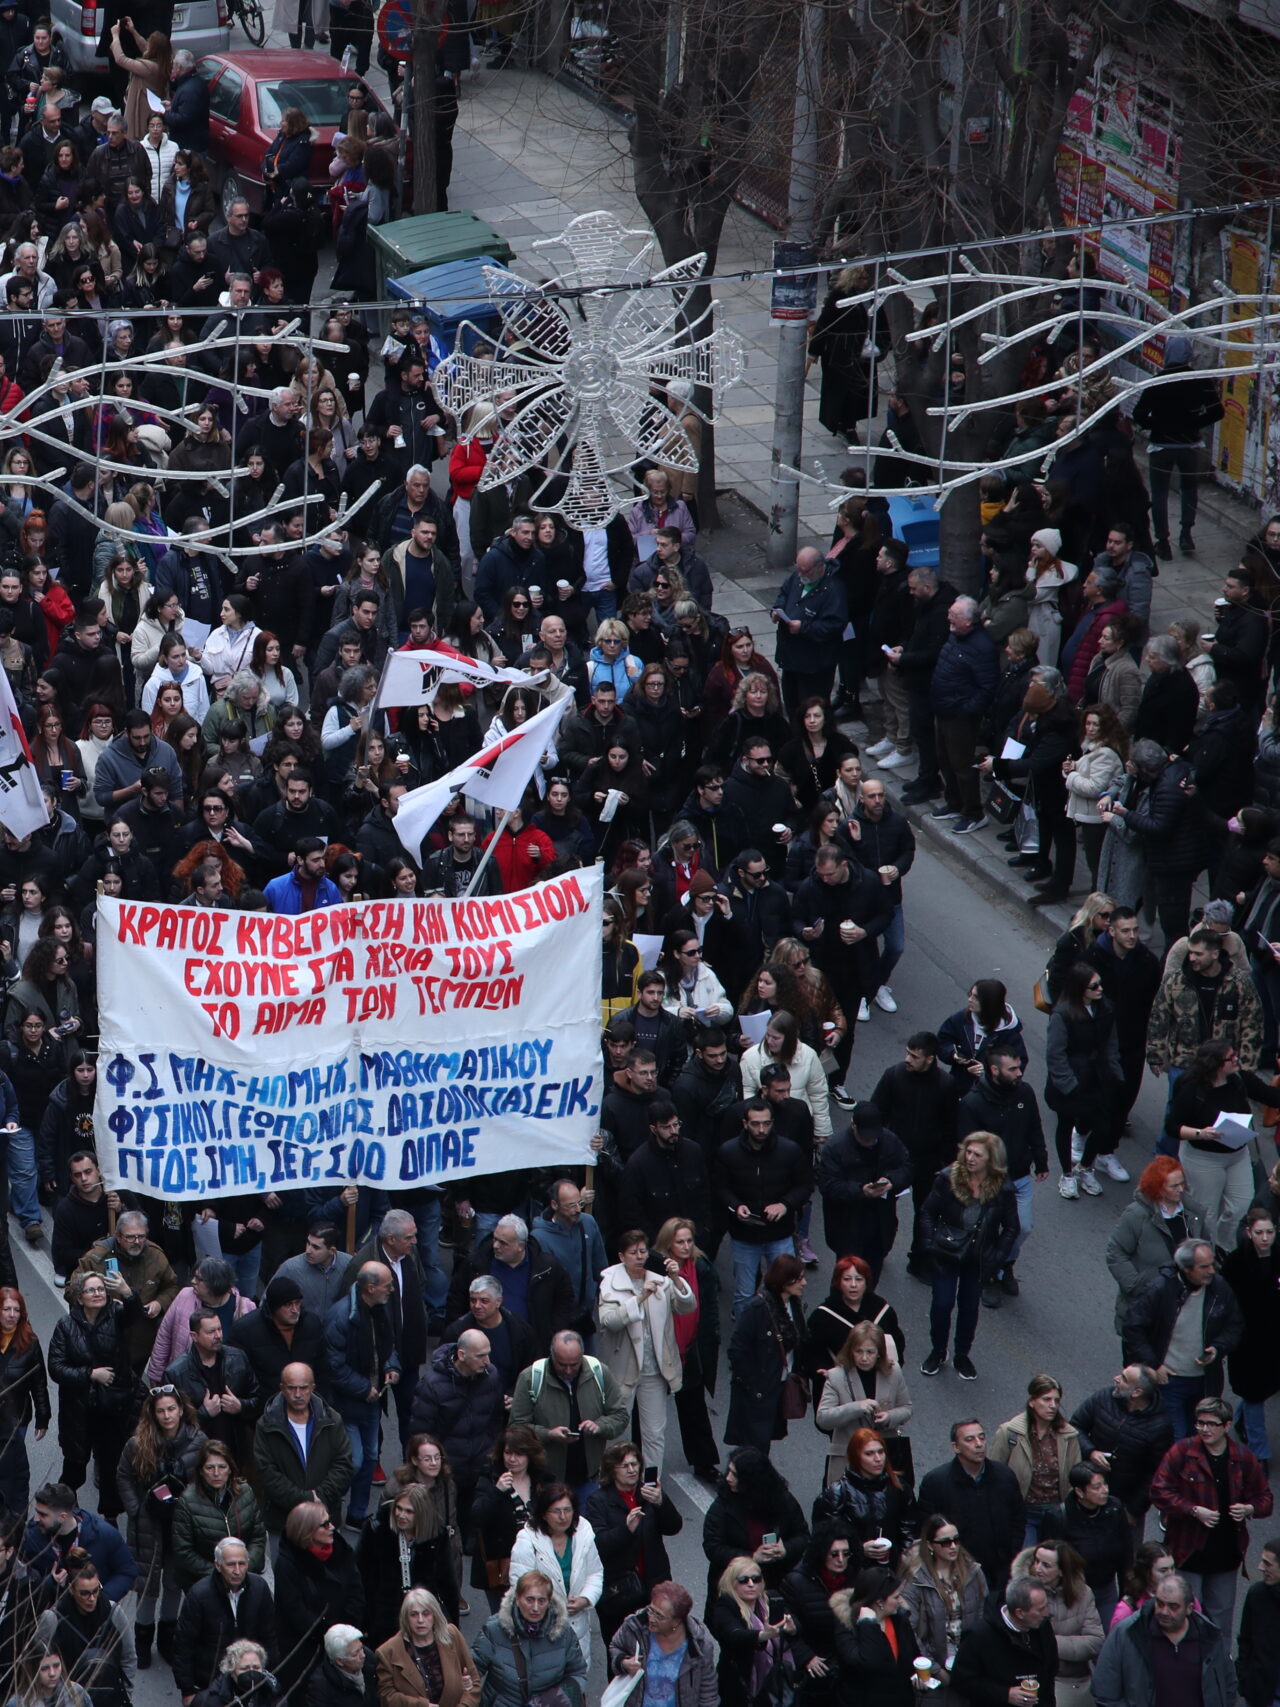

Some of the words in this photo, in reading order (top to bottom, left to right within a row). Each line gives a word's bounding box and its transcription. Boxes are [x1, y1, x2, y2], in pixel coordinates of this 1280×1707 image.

[118, 904, 229, 955] ΚΡΑΤΟΣ
[237, 903, 405, 959] ΚΥΒΕΡΝΗΣΗ
[412, 903, 449, 945] ΚΑΙ
[452, 876, 590, 942] ΚΟΜΙΣΙΟΝ,
[184, 958, 299, 997] ΕΧΟΥΝΕ
[308, 947, 355, 993] ΣΤΑ
[365, 942, 433, 979] ΧΕΡΙΑ
[444, 939, 515, 980] ΤΟΥΣ
[201, 1002, 240, 1041] ΤΟ
[252, 996, 326, 1035] ΑΙΜΑ
[342, 983, 397, 1023] ΤΩΝ
[412, 974, 525, 1015] ΤΕΜΠΩΝ
[358, 1038, 553, 1091] ΜΑΘΗΜΑΤΙΚΟΥ
[398, 1126, 481, 1182] ΔΙΠΑΕ
